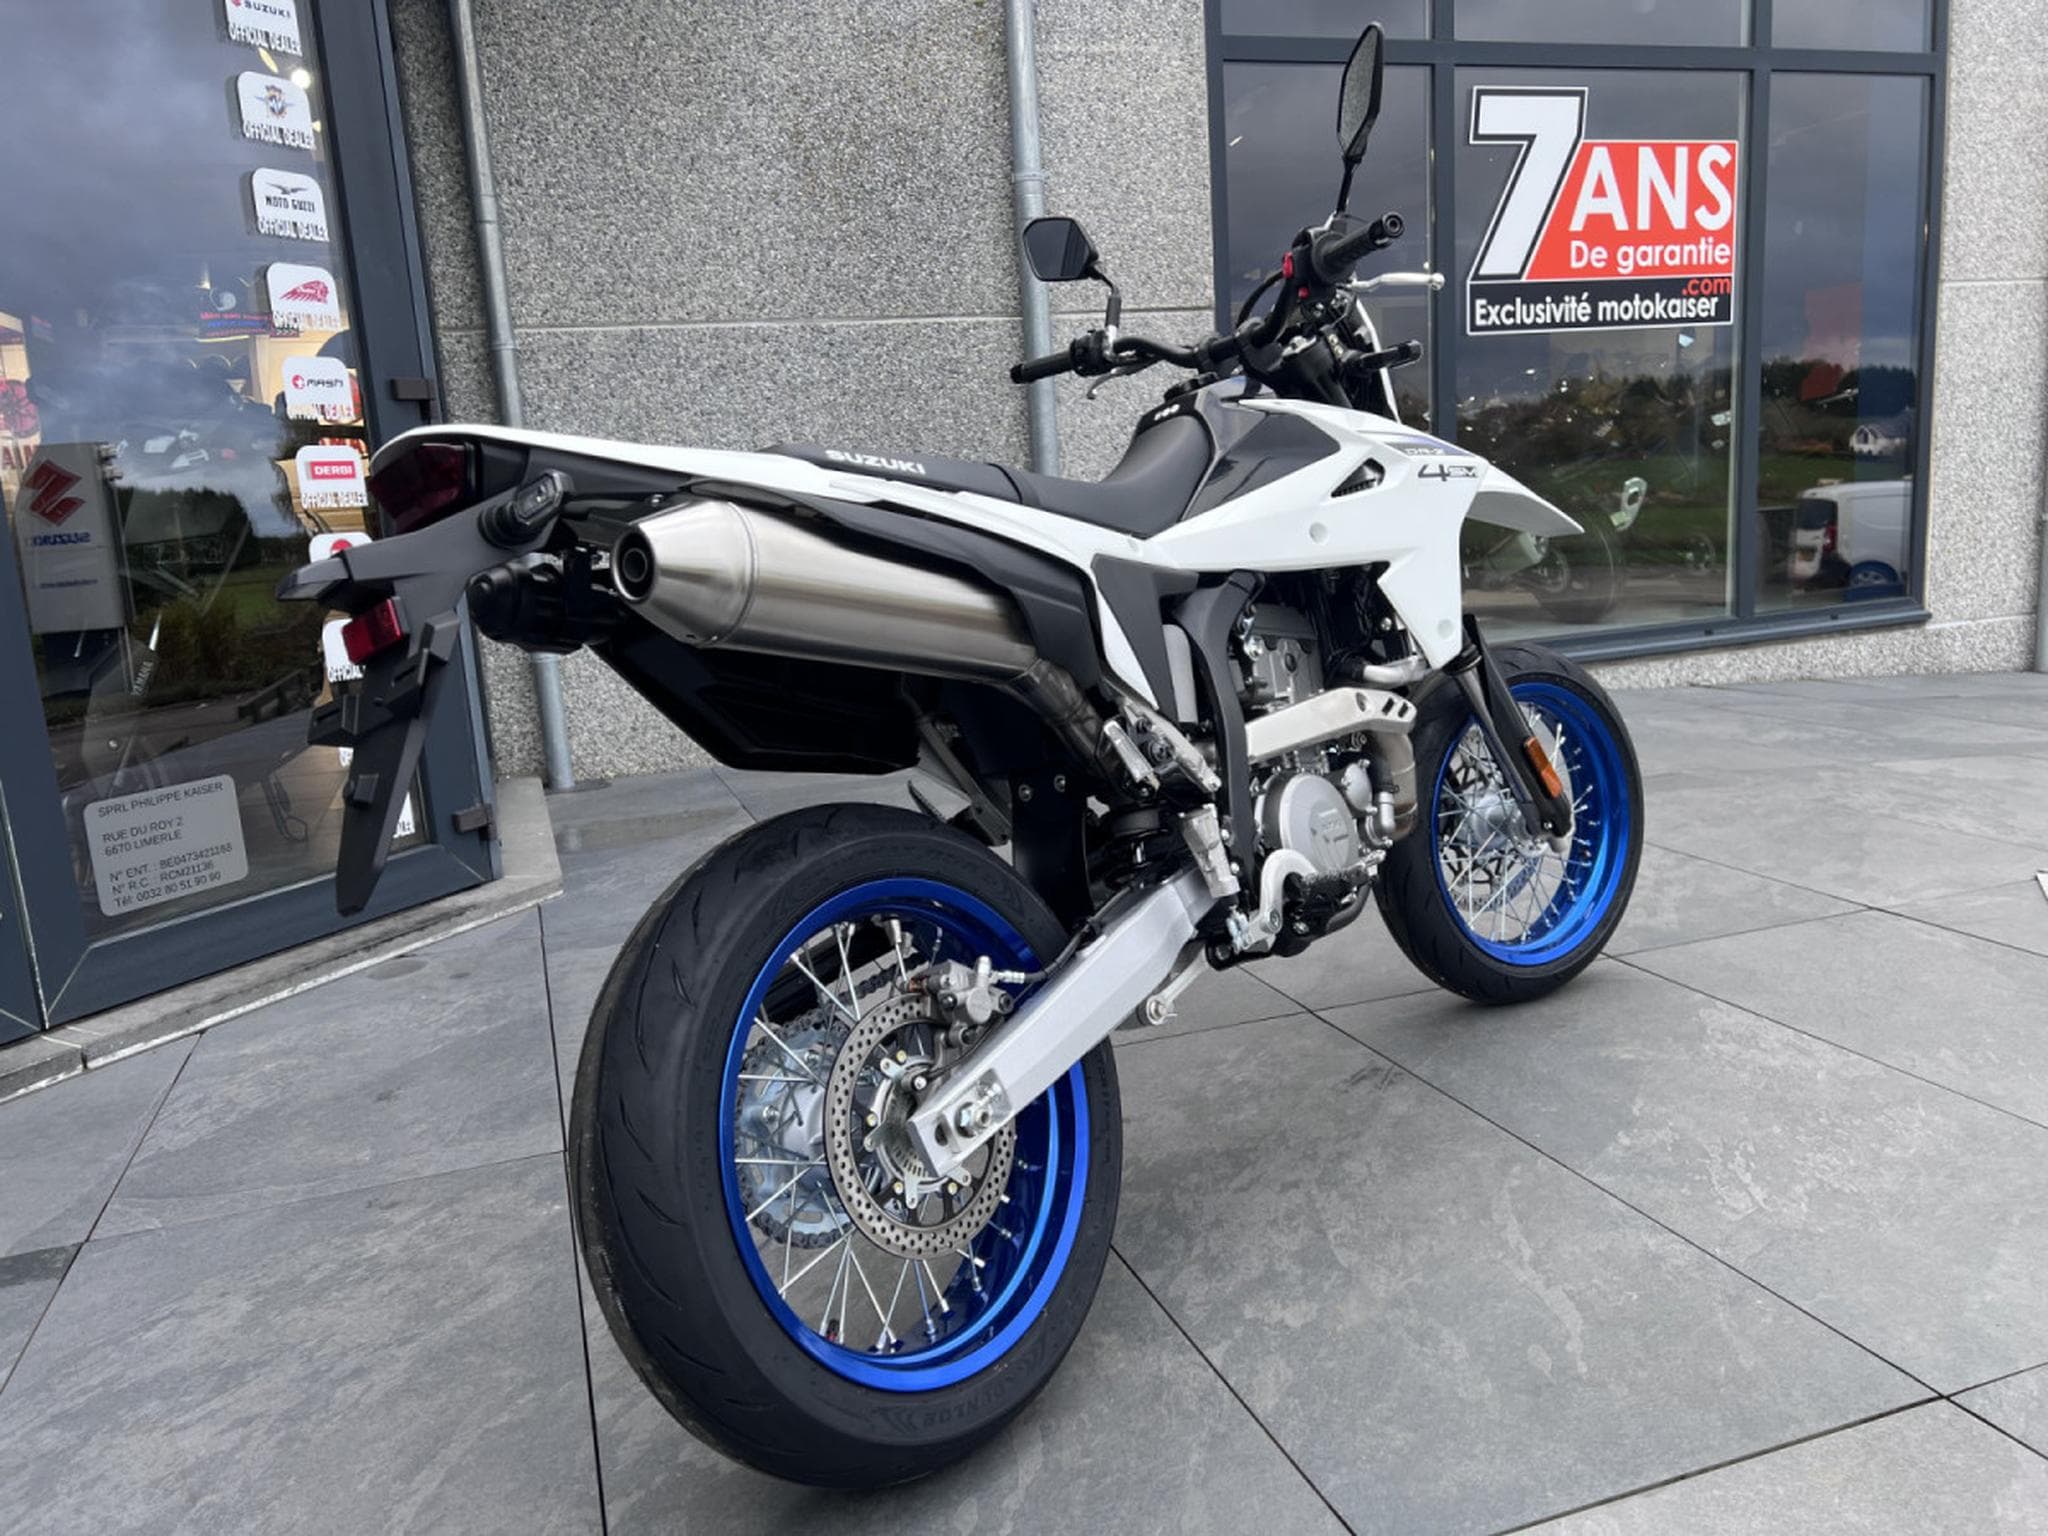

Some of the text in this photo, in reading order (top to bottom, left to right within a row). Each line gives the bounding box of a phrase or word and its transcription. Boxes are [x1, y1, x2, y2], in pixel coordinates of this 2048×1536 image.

[244, 0, 291, 18] SUZUKI
[229, 22, 303, 57] OFFICIAL DEALER
[242, 120, 316, 151] OFFICIAL DEALER
[1471, 88, 1733, 281] 7 ANS
[265, 195, 316, 213] MOTO GUZZI
[257, 216, 330, 243] OFFICIAL DEALER
[1570, 236, 1731, 275] De garantie
[1681, 278, 1731, 296] .com
[1474, 292, 1719, 326] Exclusivité motokaiser
[313, 464, 354, 476] DERBI
[825, 449, 926, 476] SUZUKI
[301, 491, 337, 511] OFFICIAL
[98, 781, 224, 818] SPRL PHILIPPE KAISER
[102, 828, 127, 843] RUE
[129, 824, 148, 838] DU
[149, 818, 174, 832] ROY
[104, 829, 182, 857] 6670 LIMERLE
[135, 886, 163, 902] 0032
[179, 878, 192, 891] 51
